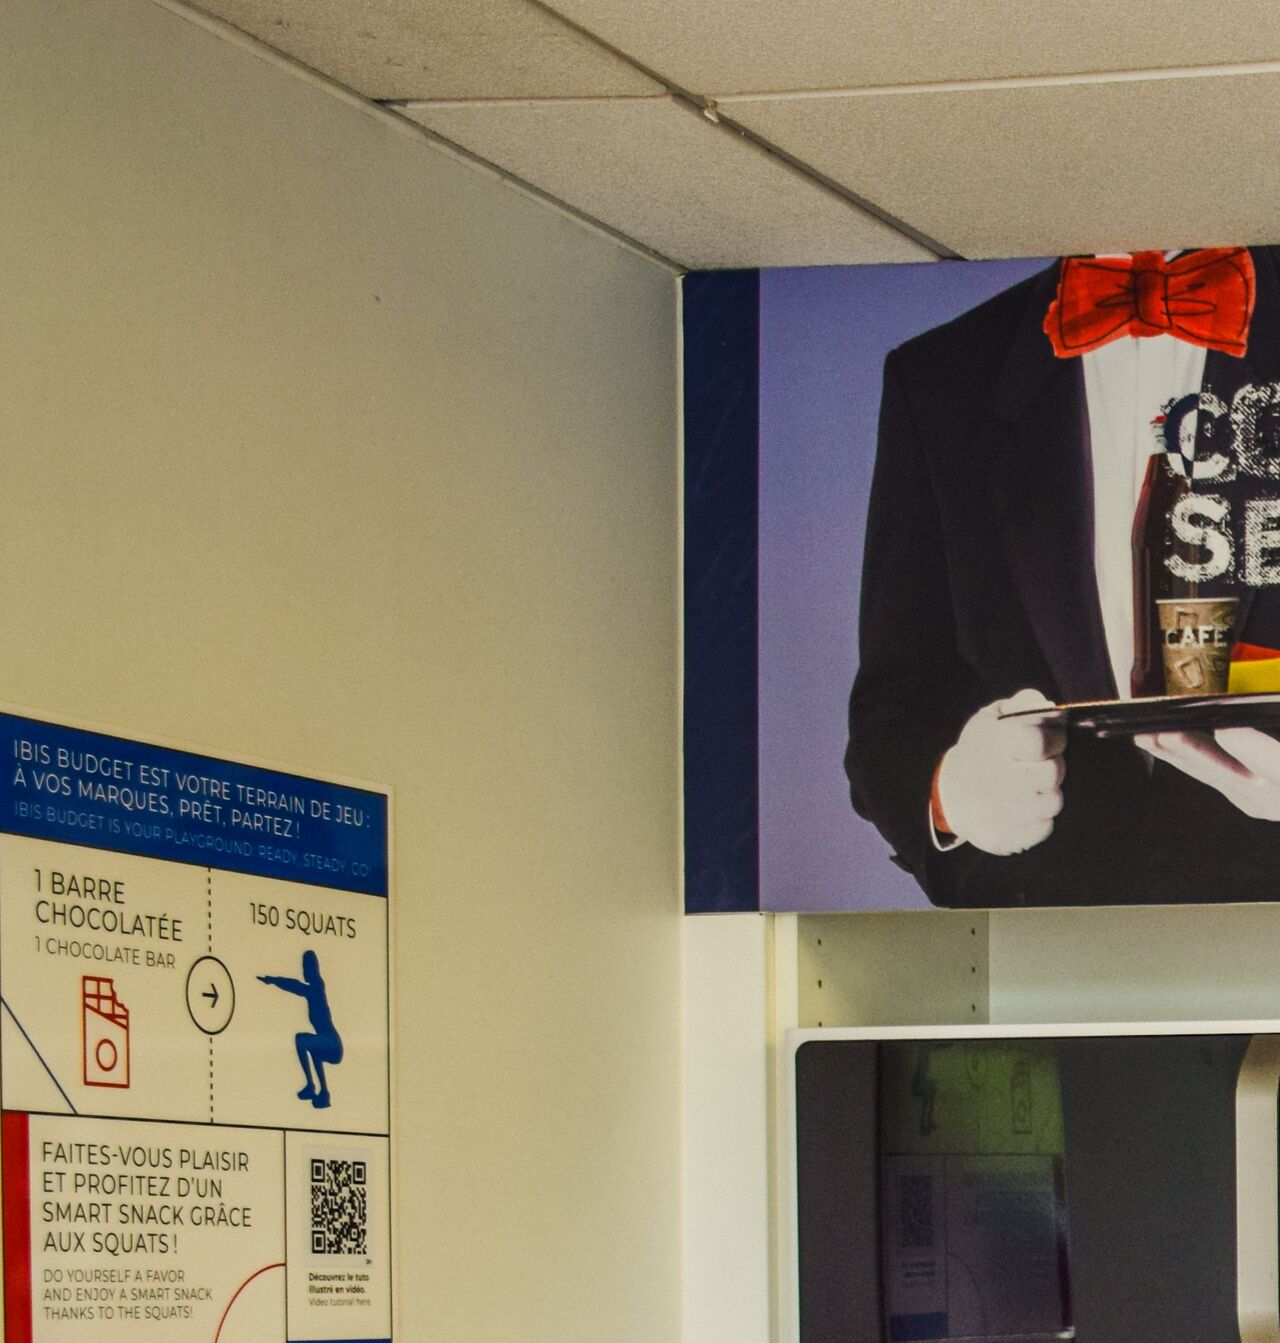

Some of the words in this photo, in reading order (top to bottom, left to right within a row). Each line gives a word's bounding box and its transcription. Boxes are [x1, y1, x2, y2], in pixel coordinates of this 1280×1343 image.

[14, 739, 50, 765] IBIS
[57, 748, 134, 781] BUDGET
[140, 764, 170, 788] EST
[175, 772, 231, 801] VOTRE
[236, 784, 305, 815] TERRAIN
[310, 800, 331, 821] DE
[14, 762, 27, 788] À
[32, 770, 72, 796] VOS
[78, 778, 174, 818] MARQUES,
[14, 801, 42, 820] IBIS
[46, 806, 104, 830] BUDGET
[109, 818, 121, 834] IS
[124, 821, 161, 841] YOUR
[34, 868, 42, 892] 1
[52, 871, 126, 904] BARRE
[35, 901, 184, 942] CHOCOLATÉE
[250, 902, 280, 928] 150
[285, 908, 357, 939] SQUATS
[46, 938, 141, 966] CHOCOLATE
[146, 949, 176, 970] BAR
[42, 1141, 173, 1169] FAITES-VOUS
[180, 1149, 250, 1173] PLAISIR
[42, 1171, 66, 1194] ET
[74, 1173, 171, 1198] PROFITEZ
[178, 1177, 223, 1199] D'UN
[42, 1202, 111, 1225] SMART
[119, 1203, 185, 1227] SNACK
[190, 1202, 253, 1228] GRÂCE
[43, 1232, 85, 1254] AUX
[43, 1269, 64, 1284] DO
[67, 1269, 132, 1285] YOURSELF
[146, 1269, 186, 1284] FAVOR
[43, 1288, 73, 1302] AND
[76, 1288, 116, 1302] ENJOY
[131, 1288, 172, 1302] SMART
[174, 1288, 213, 1302] SNACK
[43, 1306, 95, 1321] THANKS
[98, 1306, 115, 1321] TO
[117, 1306, 141, 1321] THE
